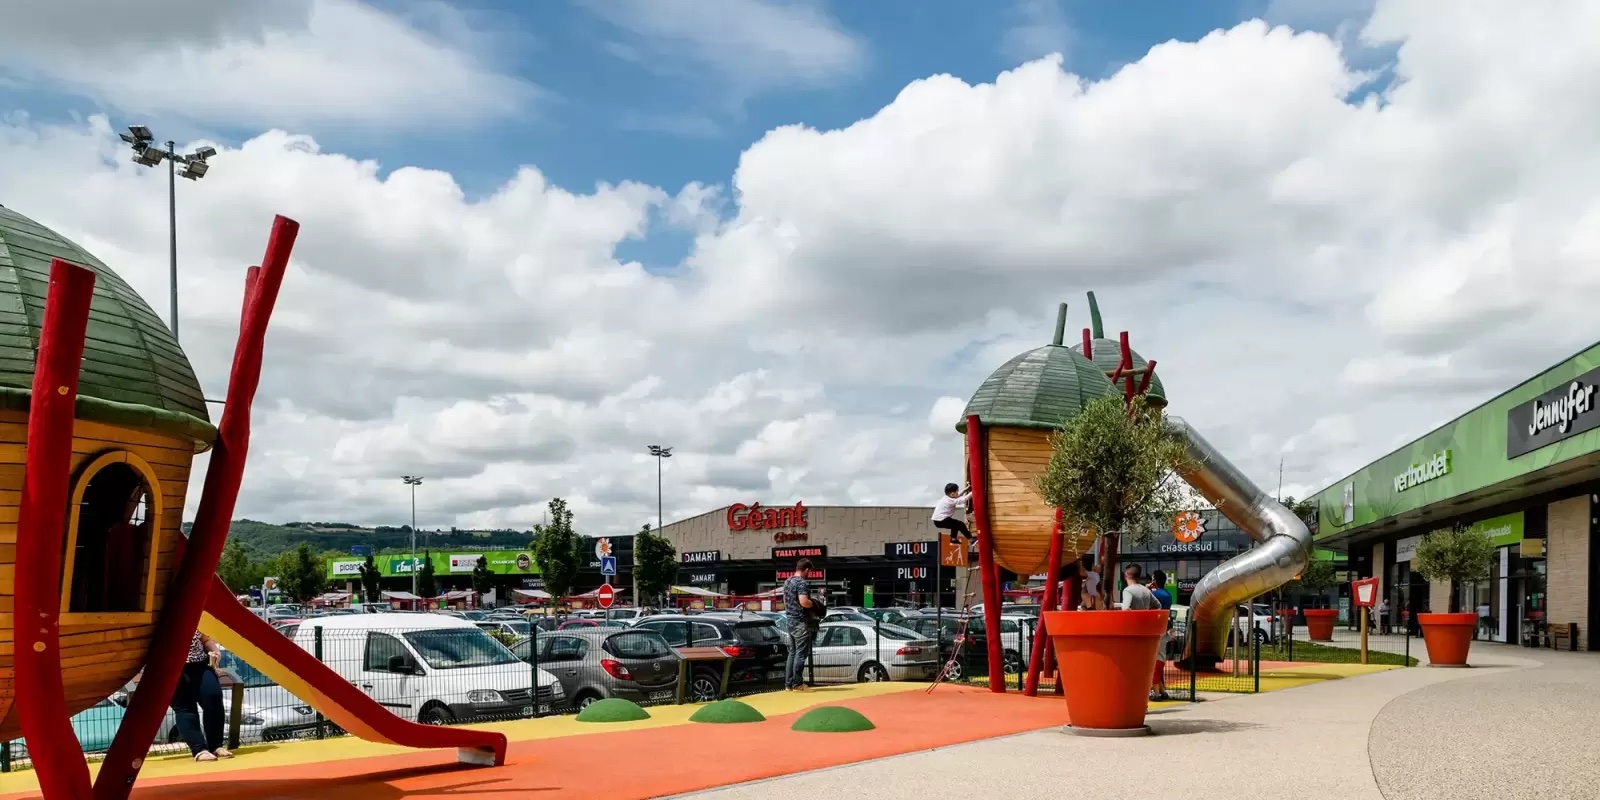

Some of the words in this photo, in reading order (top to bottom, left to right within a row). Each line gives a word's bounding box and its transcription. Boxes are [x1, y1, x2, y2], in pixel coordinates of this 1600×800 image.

[1528, 381, 1594, 436] Jennyfer
[1394, 449, 1449, 493] vertbaudet
[726, 500, 808, 532] Géant
[775, 549, 797, 557] TALLY
[896, 542, 928, 555] PILOU
[683, 551, 717, 563] DAMART
[691, 573, 716, 583] DAMART
[897, 567, 927, 579] PILOU
